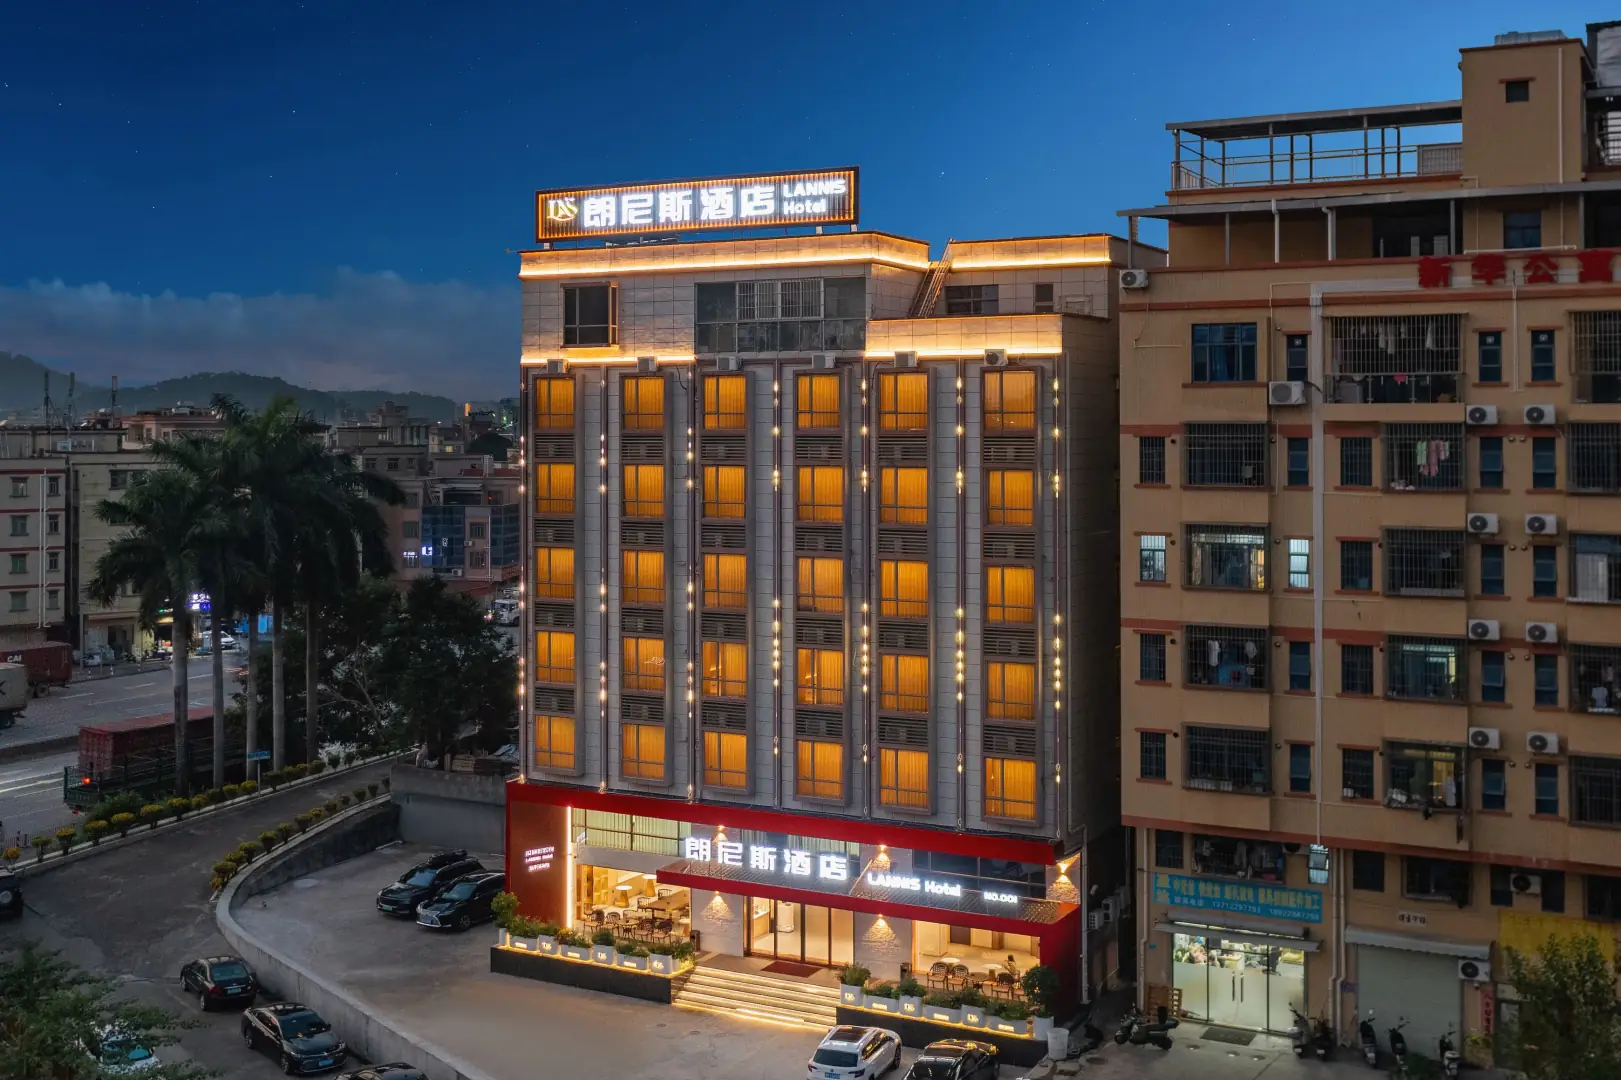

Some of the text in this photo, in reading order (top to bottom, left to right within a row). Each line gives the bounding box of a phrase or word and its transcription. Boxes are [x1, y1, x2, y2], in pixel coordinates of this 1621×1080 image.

[584, 185, 775, 228] 朗尼斯酒店
[783, 199, 827, 214] Hotel
[685, 837, 848, 881] 朗尼斯酒店
[925, 880, 961, 897] Hotel
